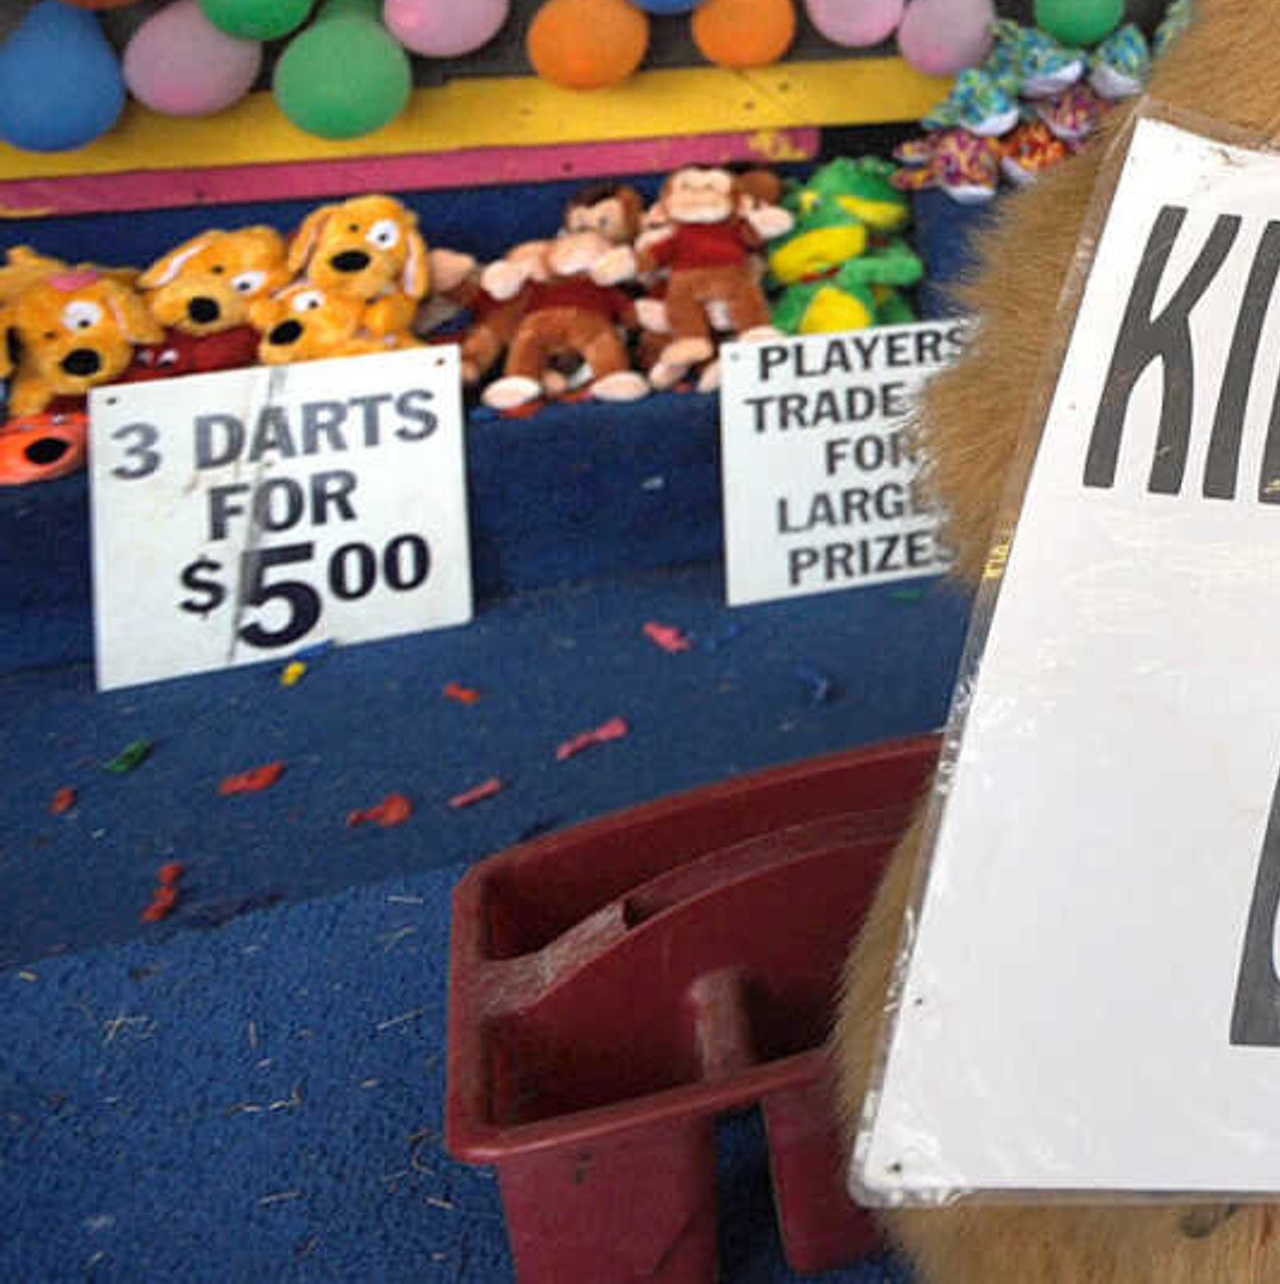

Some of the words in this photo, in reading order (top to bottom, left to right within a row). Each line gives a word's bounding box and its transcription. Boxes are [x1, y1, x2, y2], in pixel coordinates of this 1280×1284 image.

[109, 422, 162, 480] 3
[193, 389, 439, 470] DARTS
[744, 382, 908, 433] TRADE
[207, 470, 358, 542] FOR
